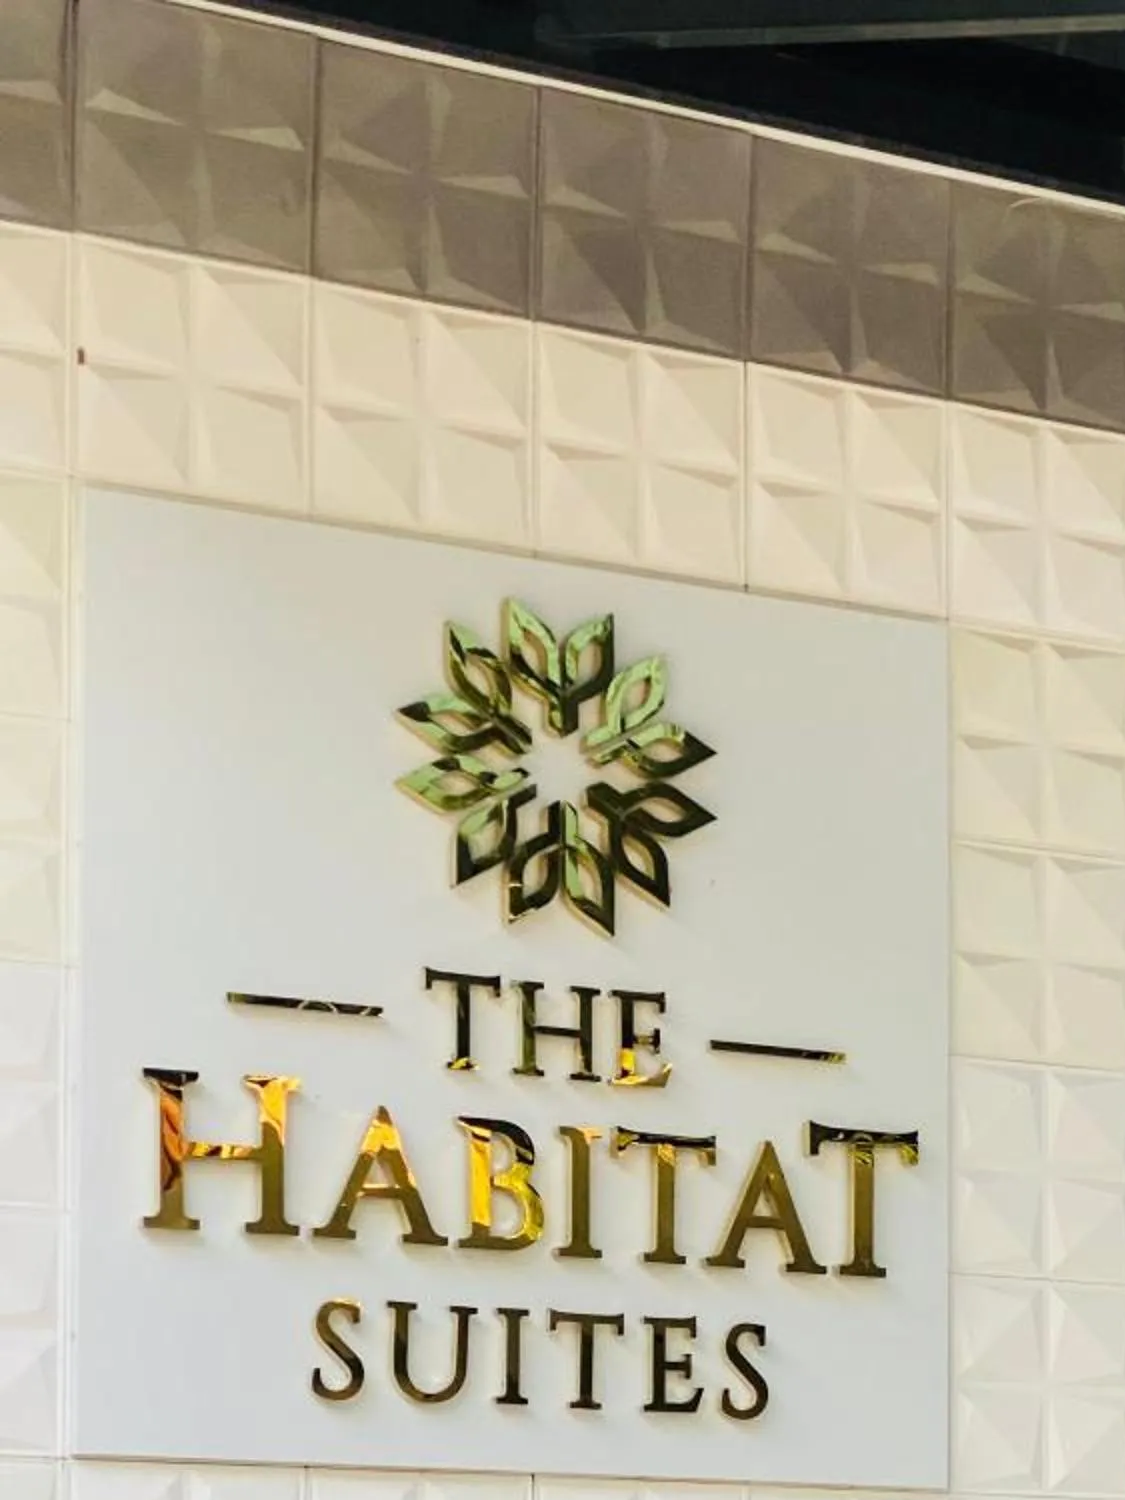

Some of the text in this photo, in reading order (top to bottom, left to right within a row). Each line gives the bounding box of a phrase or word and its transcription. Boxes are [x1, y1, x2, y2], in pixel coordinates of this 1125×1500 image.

[424, 966, 673, 1088] THE
[142, 1067, 920, 1278] HABITAT
[311, 1297, 768, 1421] SUITES
